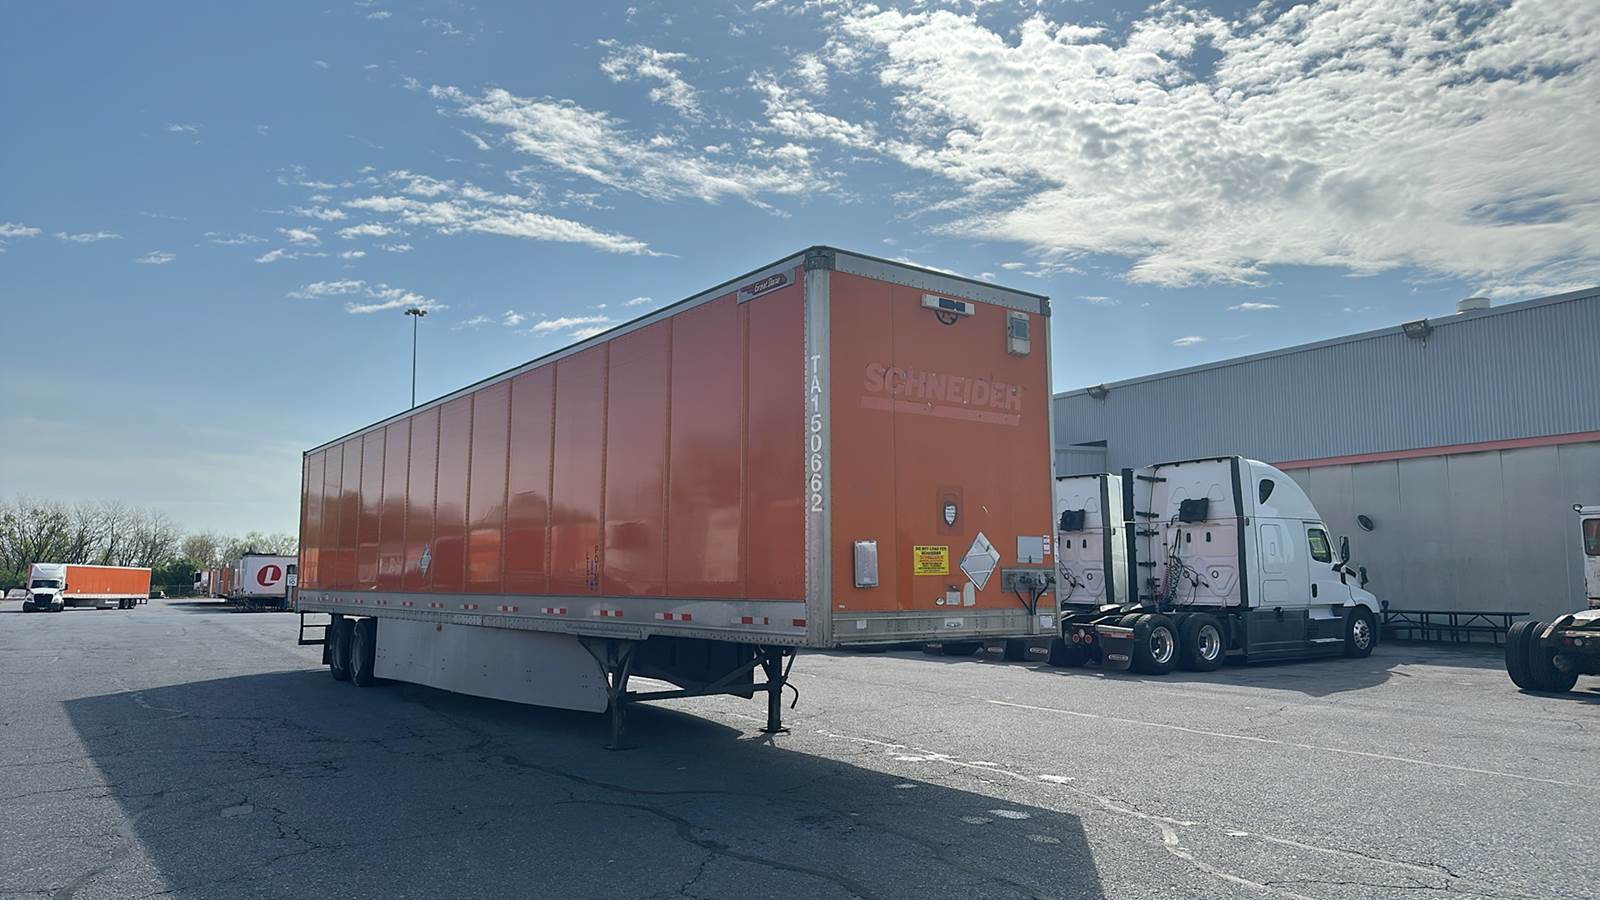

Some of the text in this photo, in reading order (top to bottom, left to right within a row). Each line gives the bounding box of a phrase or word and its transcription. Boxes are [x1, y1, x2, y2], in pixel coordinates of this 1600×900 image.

[863, 361, 1024, 411] SCHNEIDER
[810, 354, 823, 512] TA150662
[264, 567, 279, 584] L
